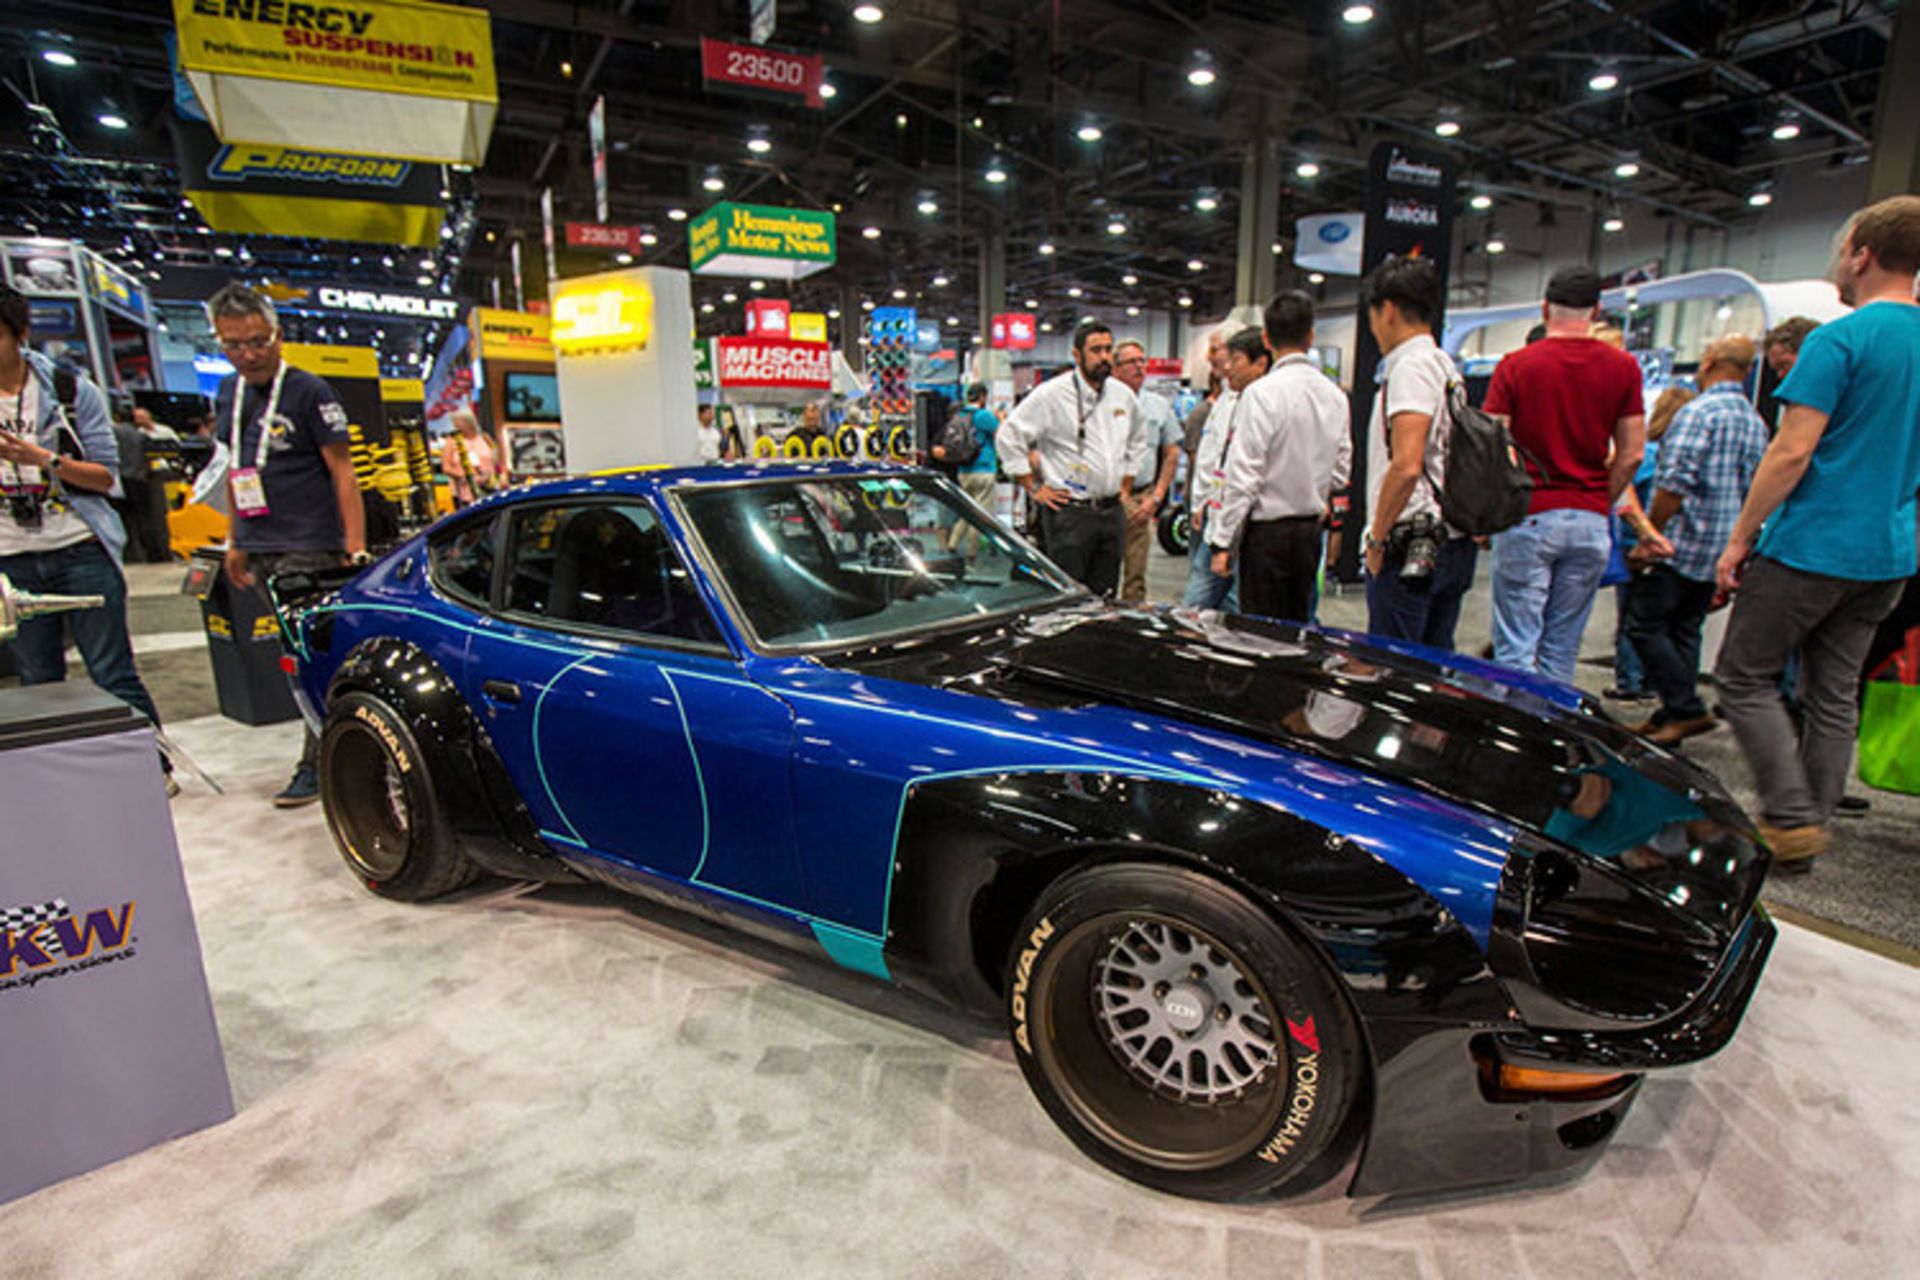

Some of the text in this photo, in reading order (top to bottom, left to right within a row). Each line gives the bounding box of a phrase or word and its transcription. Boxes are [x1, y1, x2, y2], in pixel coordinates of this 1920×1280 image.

[192, 0, 374, 35] ENERGY
[727, 50, 804, 85] 23500
[219, 145, 404, 179] PROFORM
[733, 208, 825, 240] Hemmings
[1385, 200, 1440, 225] AURORA
[727, 227, 781, 252] Motor
[784, 233, 831, 255] News
[318, 287, 460, 318] CHEVROLET
[725, 346, 828, 367] MUSCLE
[725, 363, 831, 382] MACHINES
[354, 705, 411, 773] ADVAN
[1012, 916, 1056, 1056] ADVAN
[1257, 1053, 1319, 1164] YOKOHAMA
